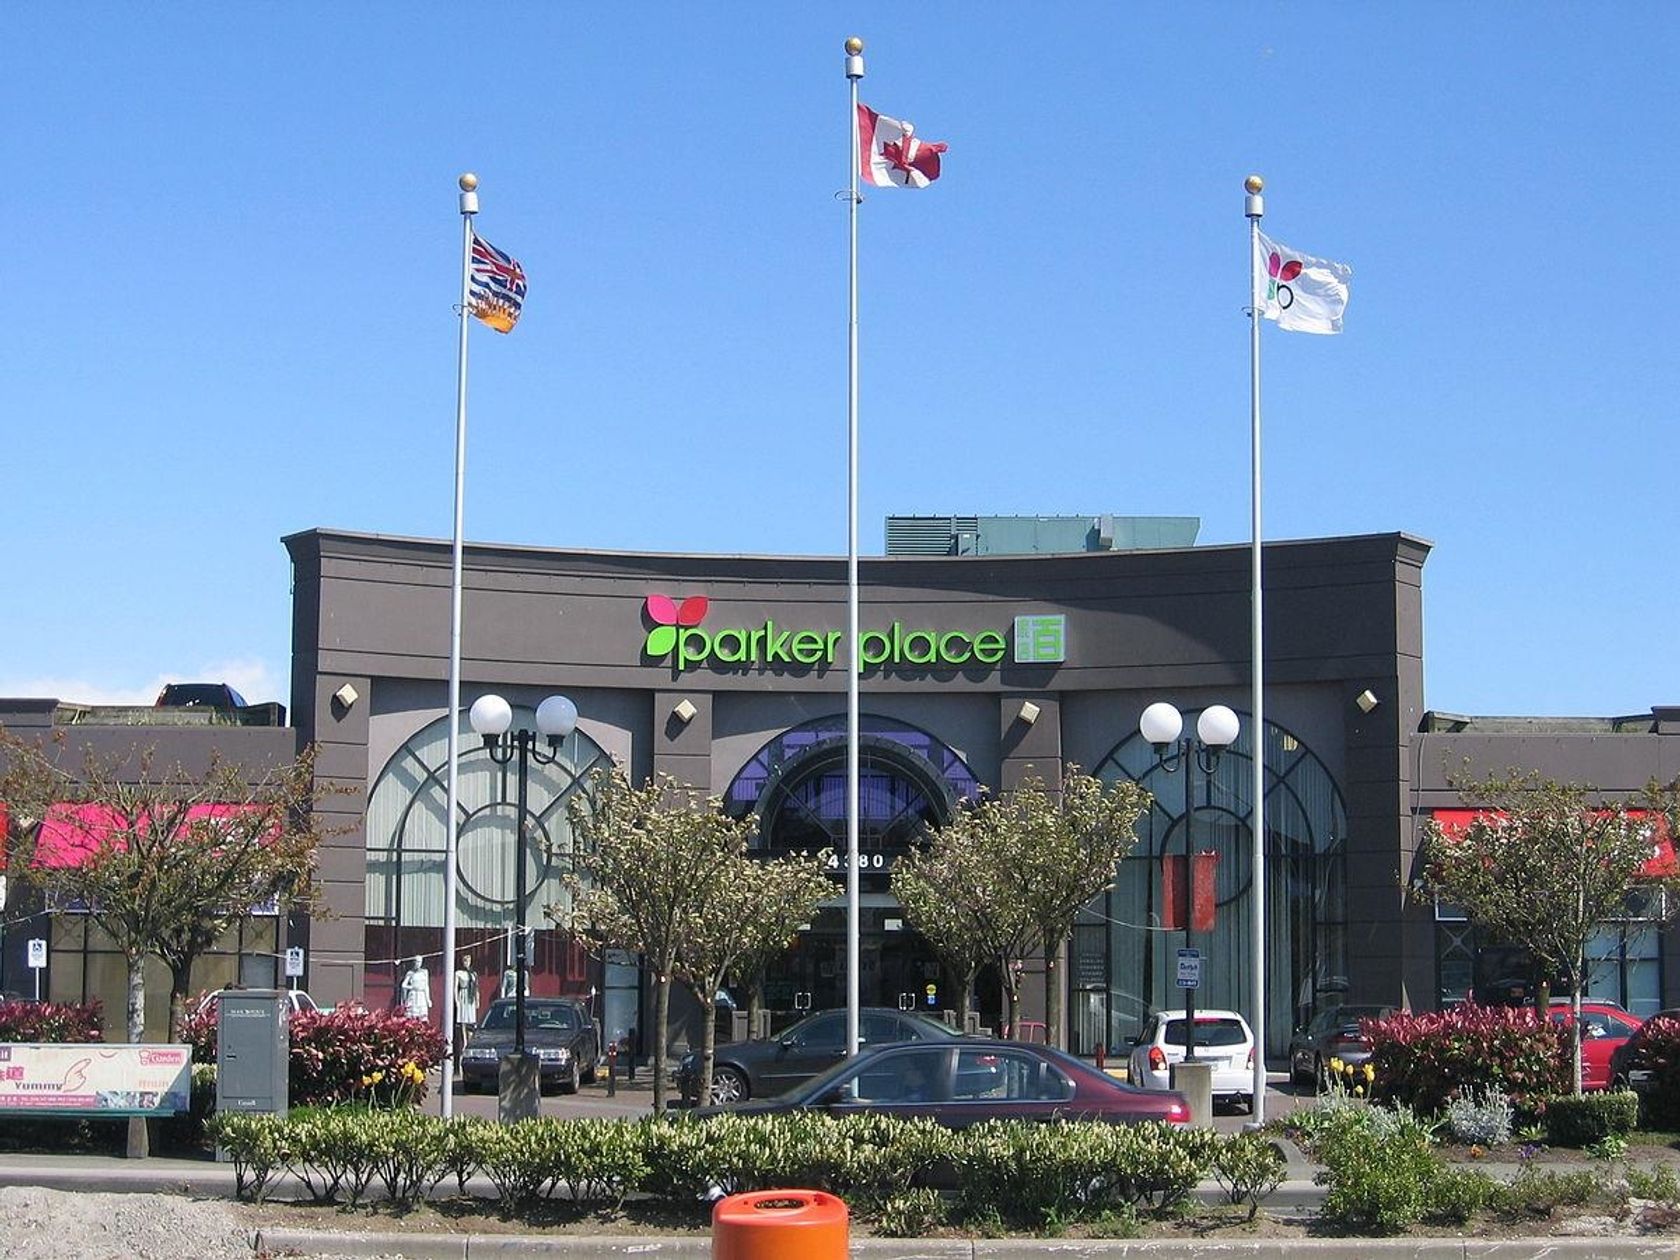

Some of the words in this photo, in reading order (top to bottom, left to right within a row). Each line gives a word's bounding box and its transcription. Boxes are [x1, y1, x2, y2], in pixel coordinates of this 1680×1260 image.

[678, 618, 841, 671] parker
[858, 620, 1007, 672] place
[15, 1082, 63, 1091] Yummy
